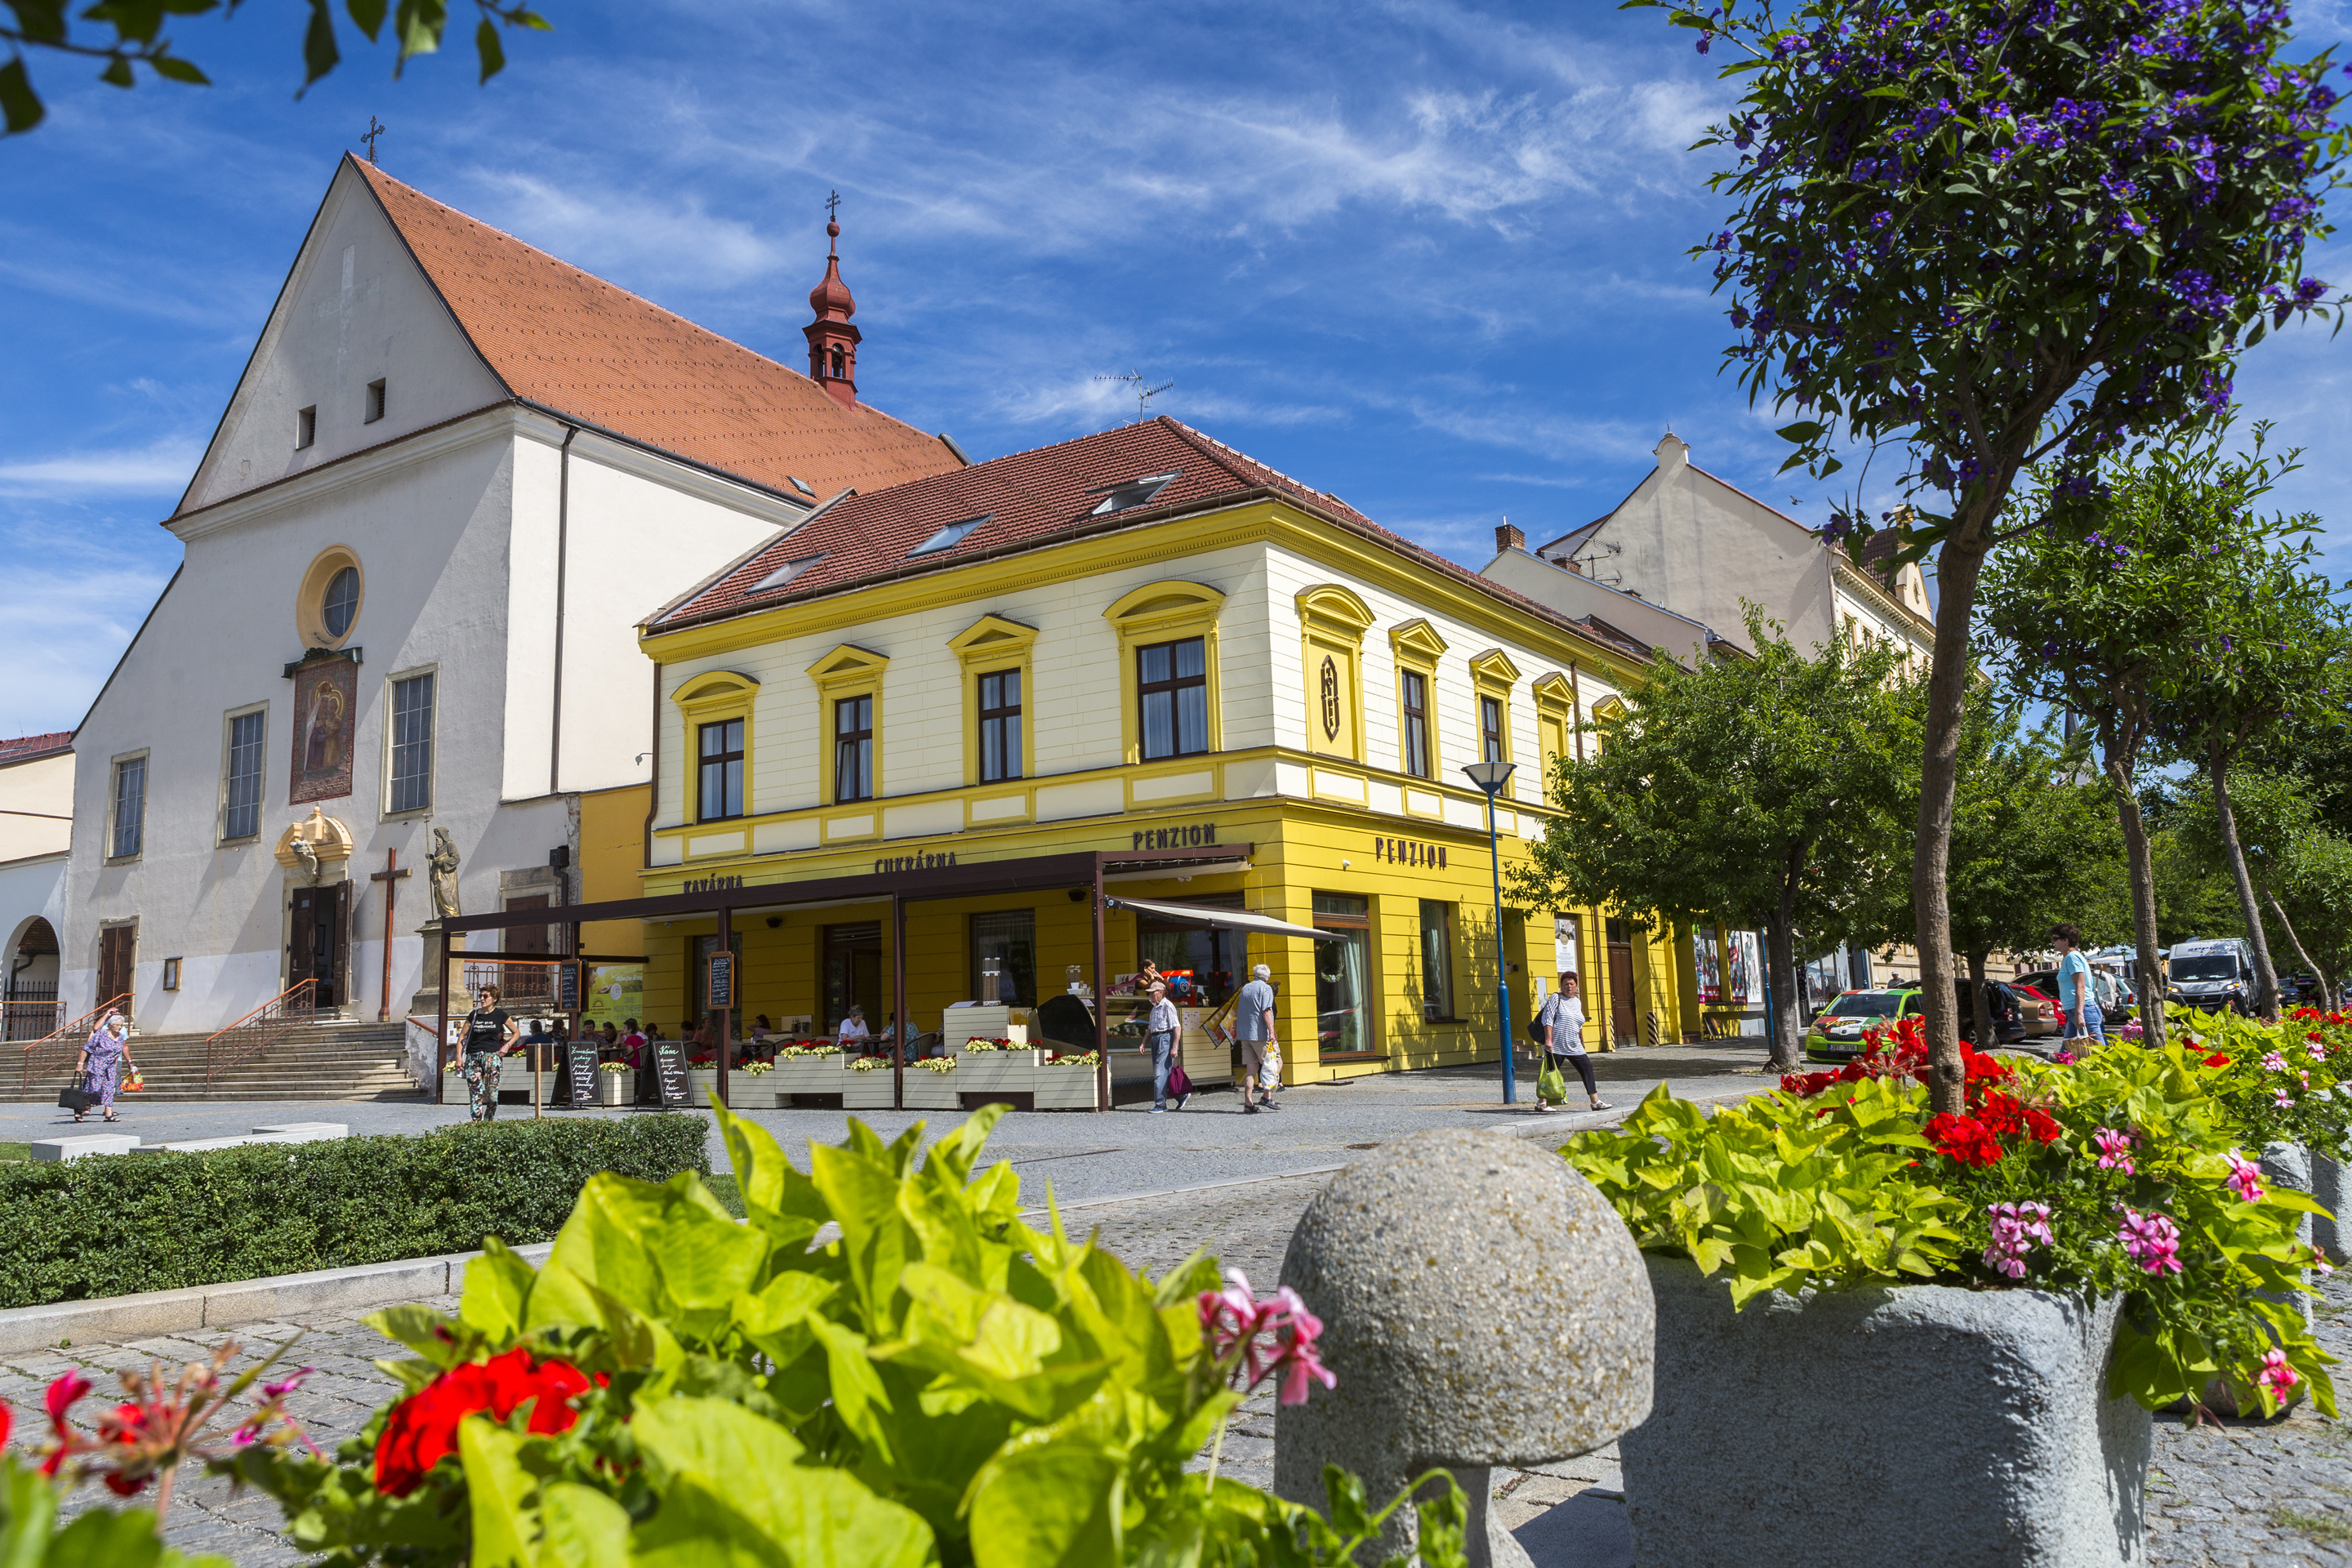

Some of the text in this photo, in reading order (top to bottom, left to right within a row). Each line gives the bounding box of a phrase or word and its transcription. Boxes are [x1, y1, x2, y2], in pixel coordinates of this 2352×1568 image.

[1133, 823, 1215, 850] PENZION
[875, 850, 956, 873] CUKRÁRNA
[1375, 837, 1447, 870] PENZION
[684, 873, 742, 894] KAVÁRNA
